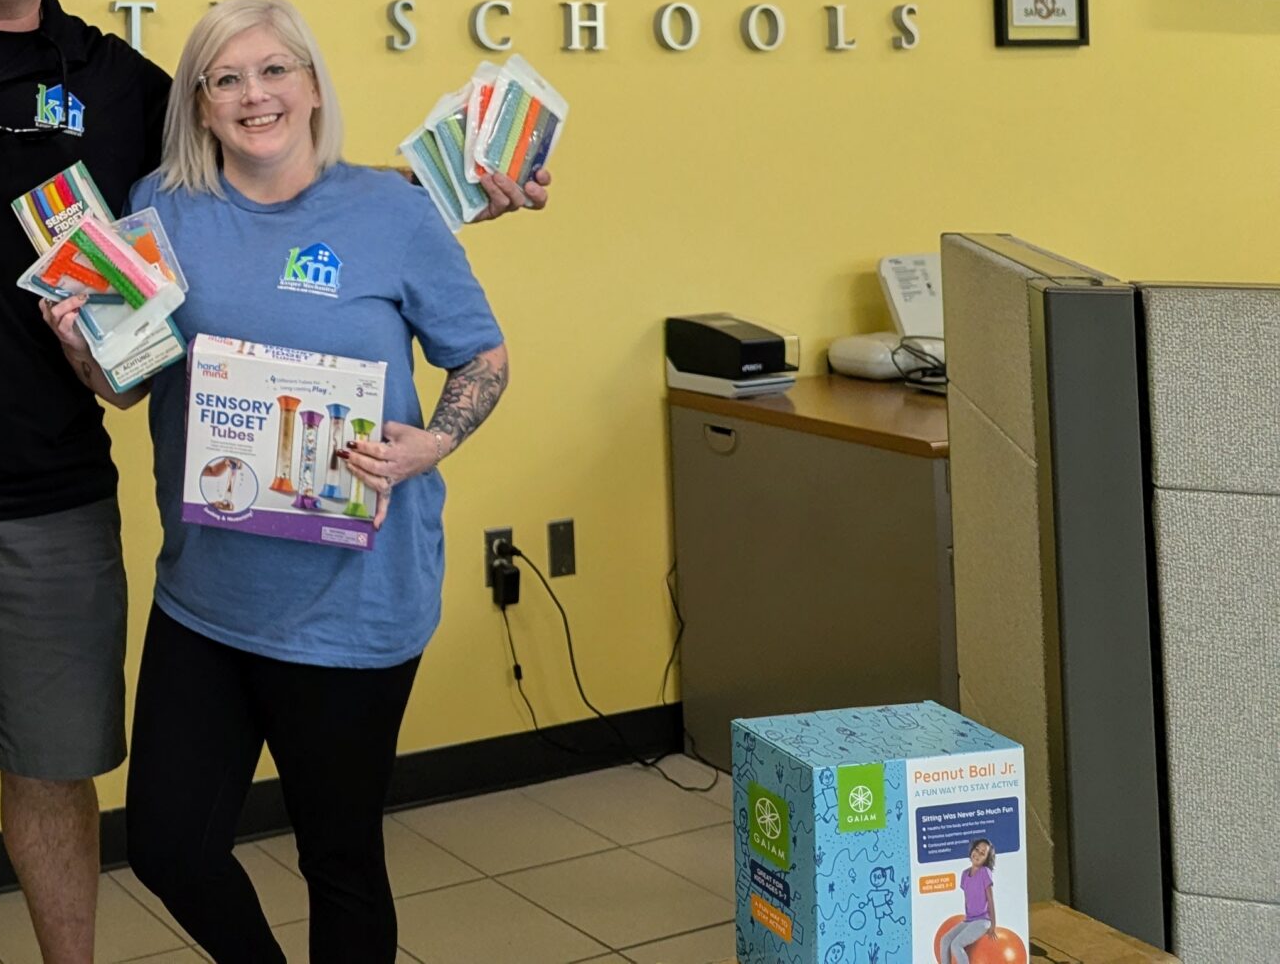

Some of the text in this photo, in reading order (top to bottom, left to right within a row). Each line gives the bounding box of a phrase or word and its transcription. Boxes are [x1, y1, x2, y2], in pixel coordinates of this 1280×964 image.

[45, 200, 84, 229] SENSORY
[284, 246, 338, 288] km
[312, 385, 327, 395] Play
[195, 392, 273, 415] SENSORY
[200, 409, 267, 431] FIDGET
[210, 425, 255, 442] Tubes
[914, 762, 1017, 784] Peanut Ball Jr.
[921, 788, 938, 797] FUN
[939, 786, 957, 795] WAY
[959, 785, 969, 793] TO
[970, 782, 990, 792] STAY
[991, 779, 1019, 789] ACTIVE
[847, 813, 877, 824] GAIAM
[921, 815, 942, 823] Sitting
[943, 813, 957, 821] Was
[957, 811, 976, 819] Never
[986, 807, 1002, 815] Much
[753, 832, 786, 861] GAIAM
